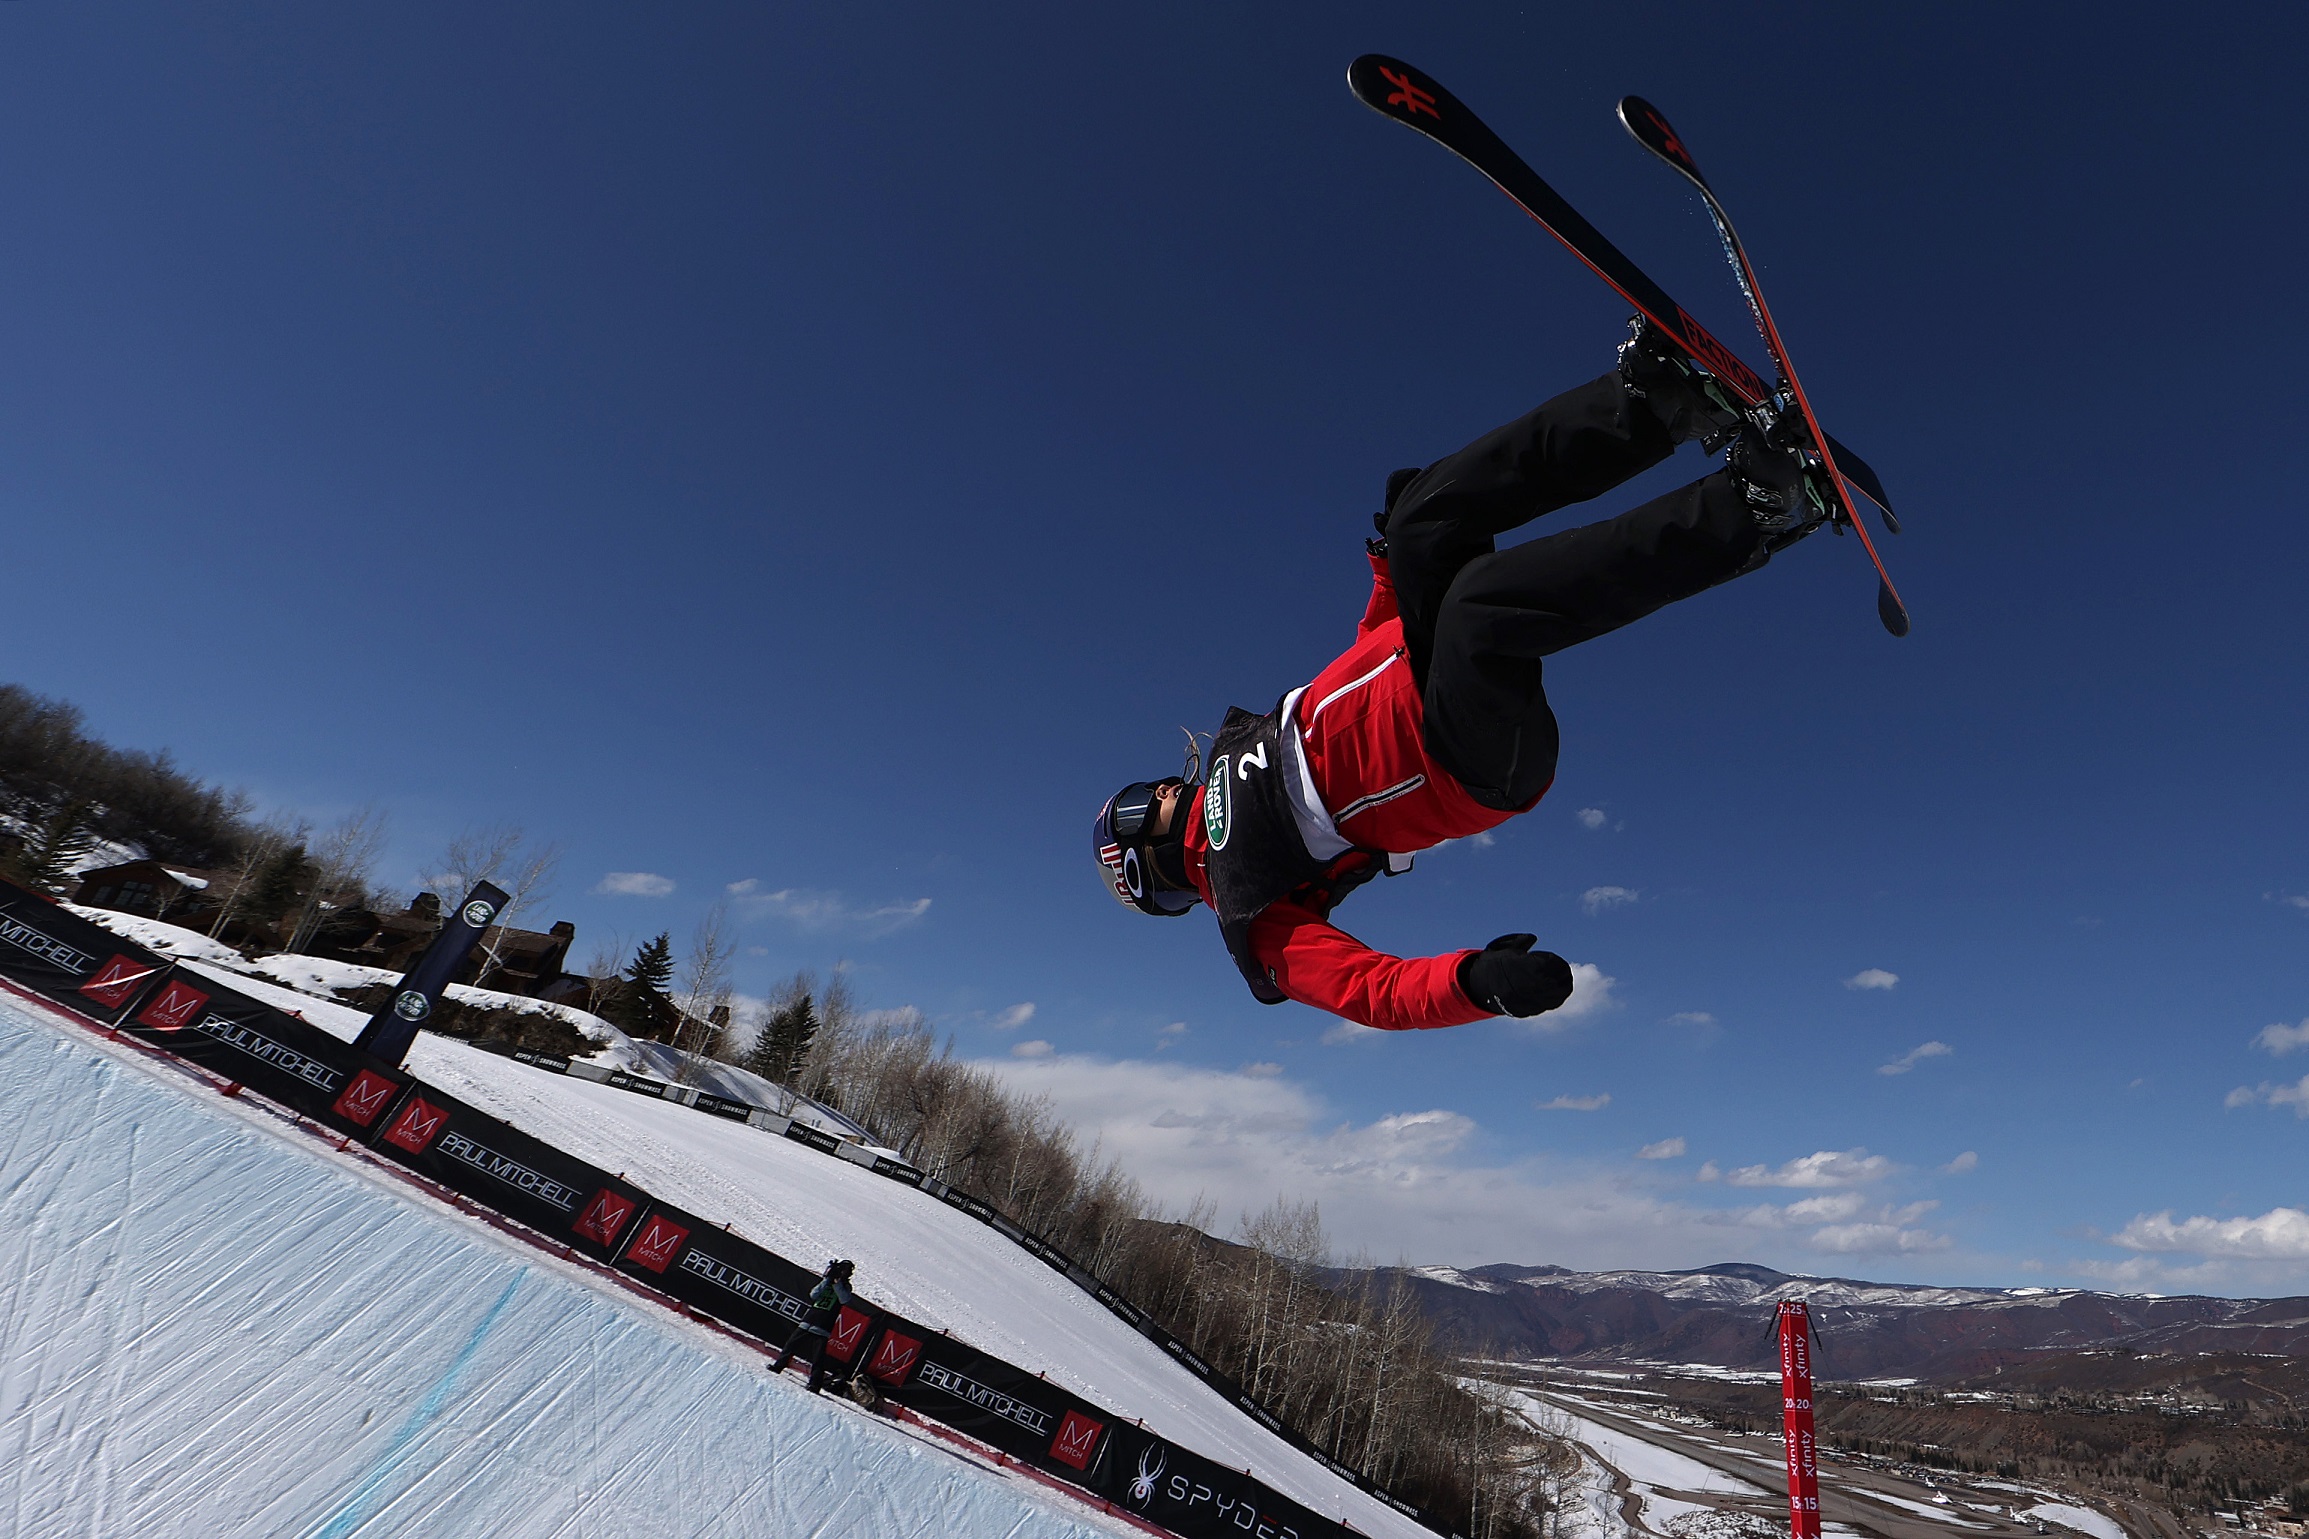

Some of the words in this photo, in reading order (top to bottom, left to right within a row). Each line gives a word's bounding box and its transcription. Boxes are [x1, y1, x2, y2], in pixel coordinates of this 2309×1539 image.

[1684, 317, 1763, 400] FACTION
[1237, 741, 1269, 781] 2
[1213, 766, 1224, 820] ROVER
[1206, 788, 1217, 831] LAND
[0, 919, 86, 974] MITCHELL
[150, 1009, 181, 1027] MITCH
[158, 989, 199, 1019] M
[197, 1015, 247, 1048] PAUL
[246, 1038, 336, 1091] MITCHELL
[343, 1100, 371, 1117] MITCH
[350, 1079, 388, 1109] M
[396, 1128, 423, 1145] MITCH
[403, 1107, 439, 1137] M
[439, 1134, 487, 1166] PAUL
[487, 1156, 576, 1210] MITCHELL
[584, 1219, 611, 1237] MITCH
[590, 1198, 626, 1229] M
[638, 1247, 664, 1263] MITCH
[644, 1225, 679, 1255] M
[682, 1250, 729, 1285] PAUL
[1789, 1304, 1803, 1315] 25
[881, 1339, 914, 1365] M
[1783, 1333, 1793, 1378] xfinity
[1794, 1333, 1809, 1379] xfinity
[919, 1363, 964, 1393] PAUL
[965, 1384, 1049, 1435] MITCHELL
[1796, 1398, 1810, 1409] 20
[1062, 1420, 1094, 1451] M
[1058, 1443, 1084, 1460] MITCH
[1788, 1429, 1798, 1477] xfinity
[1801, 1429, 1815, 1478] xfinity
[1791, 1496, 1800, 1509] 15
[1803, 1497, 1817, 1510] 15
